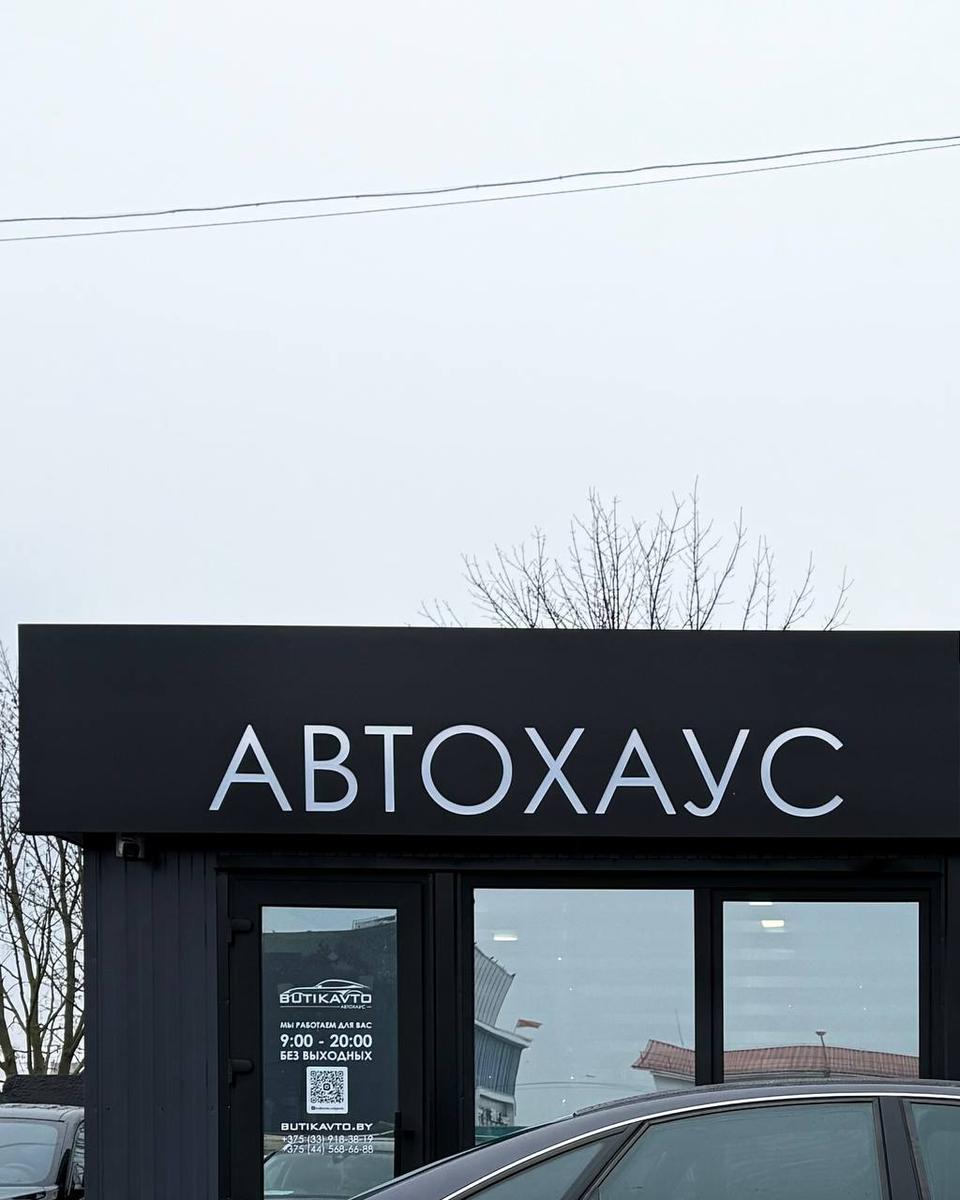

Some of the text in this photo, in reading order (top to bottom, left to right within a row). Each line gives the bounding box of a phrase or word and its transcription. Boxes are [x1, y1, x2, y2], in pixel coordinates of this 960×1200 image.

[208, 723, 845, 818] АВТОХАУС
[279, 993, 372, 1004] BUTIKAVTO
[280, 1021, 373, 1030] МЫ РАБОТАЕМ ДЛЯ ВАС
[280, 1034, 313, 1048] 9:00
[329, 1034, 373, 1048] 20:00
[280, 1050, 373, 1061] БЕЗ ВЫХОДНЫХ
[281, 1122, 373, 1131] BUTIKAVTO.BY
[327, 1144, 374, 1154] 568-66-88
